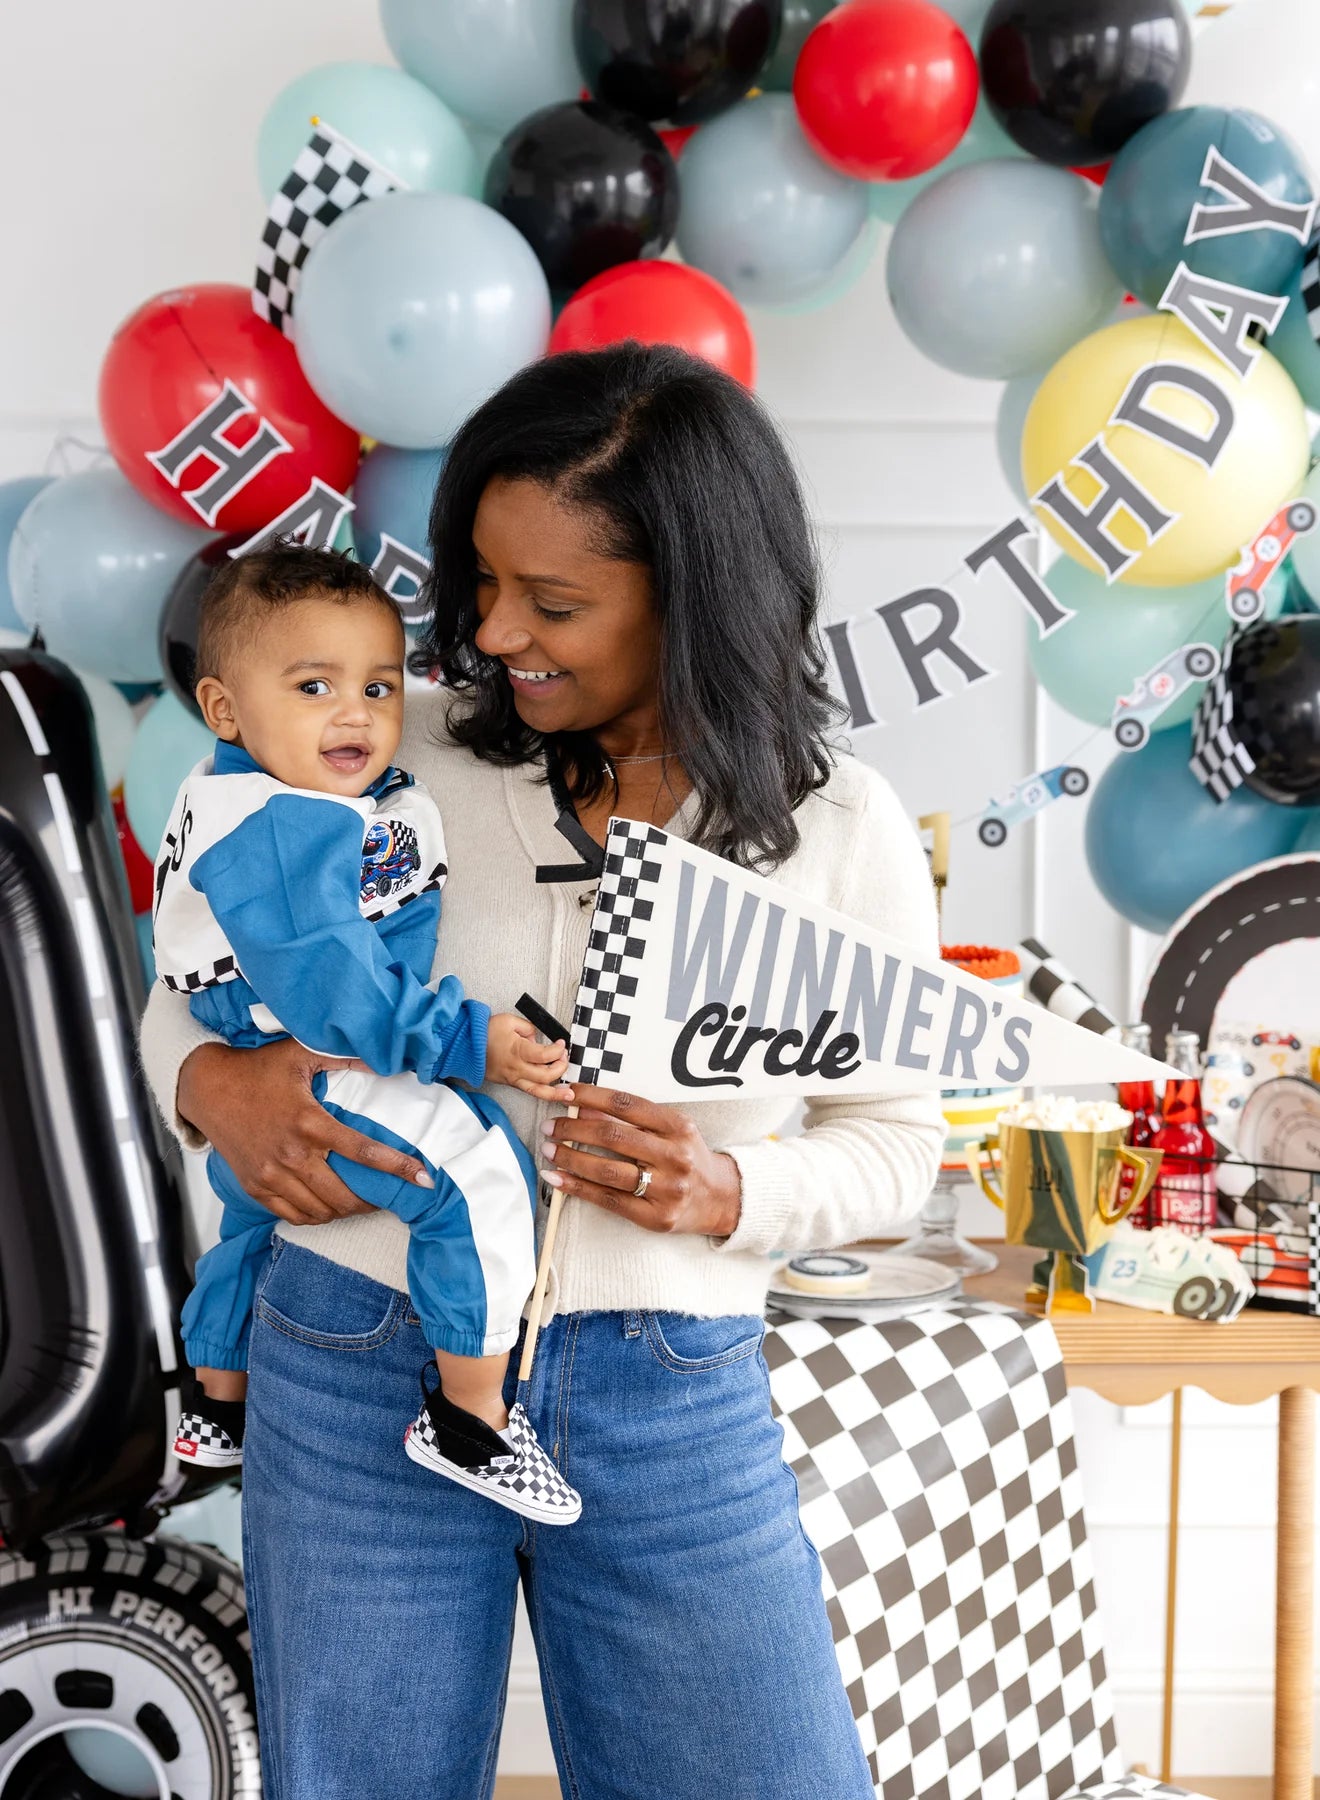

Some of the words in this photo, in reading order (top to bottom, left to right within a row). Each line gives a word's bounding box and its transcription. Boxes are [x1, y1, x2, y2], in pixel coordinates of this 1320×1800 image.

[145, 378, 437, 624] HAP
[824, 145, 1319, 728] IRTHDAY
[665, 860, 1032, 1083] WINNER'S
[671, 1002, 862, 1088] Circle
[1112, 1259, 1137, 1278] 23
[49, 1587, 94, 1618] HI
